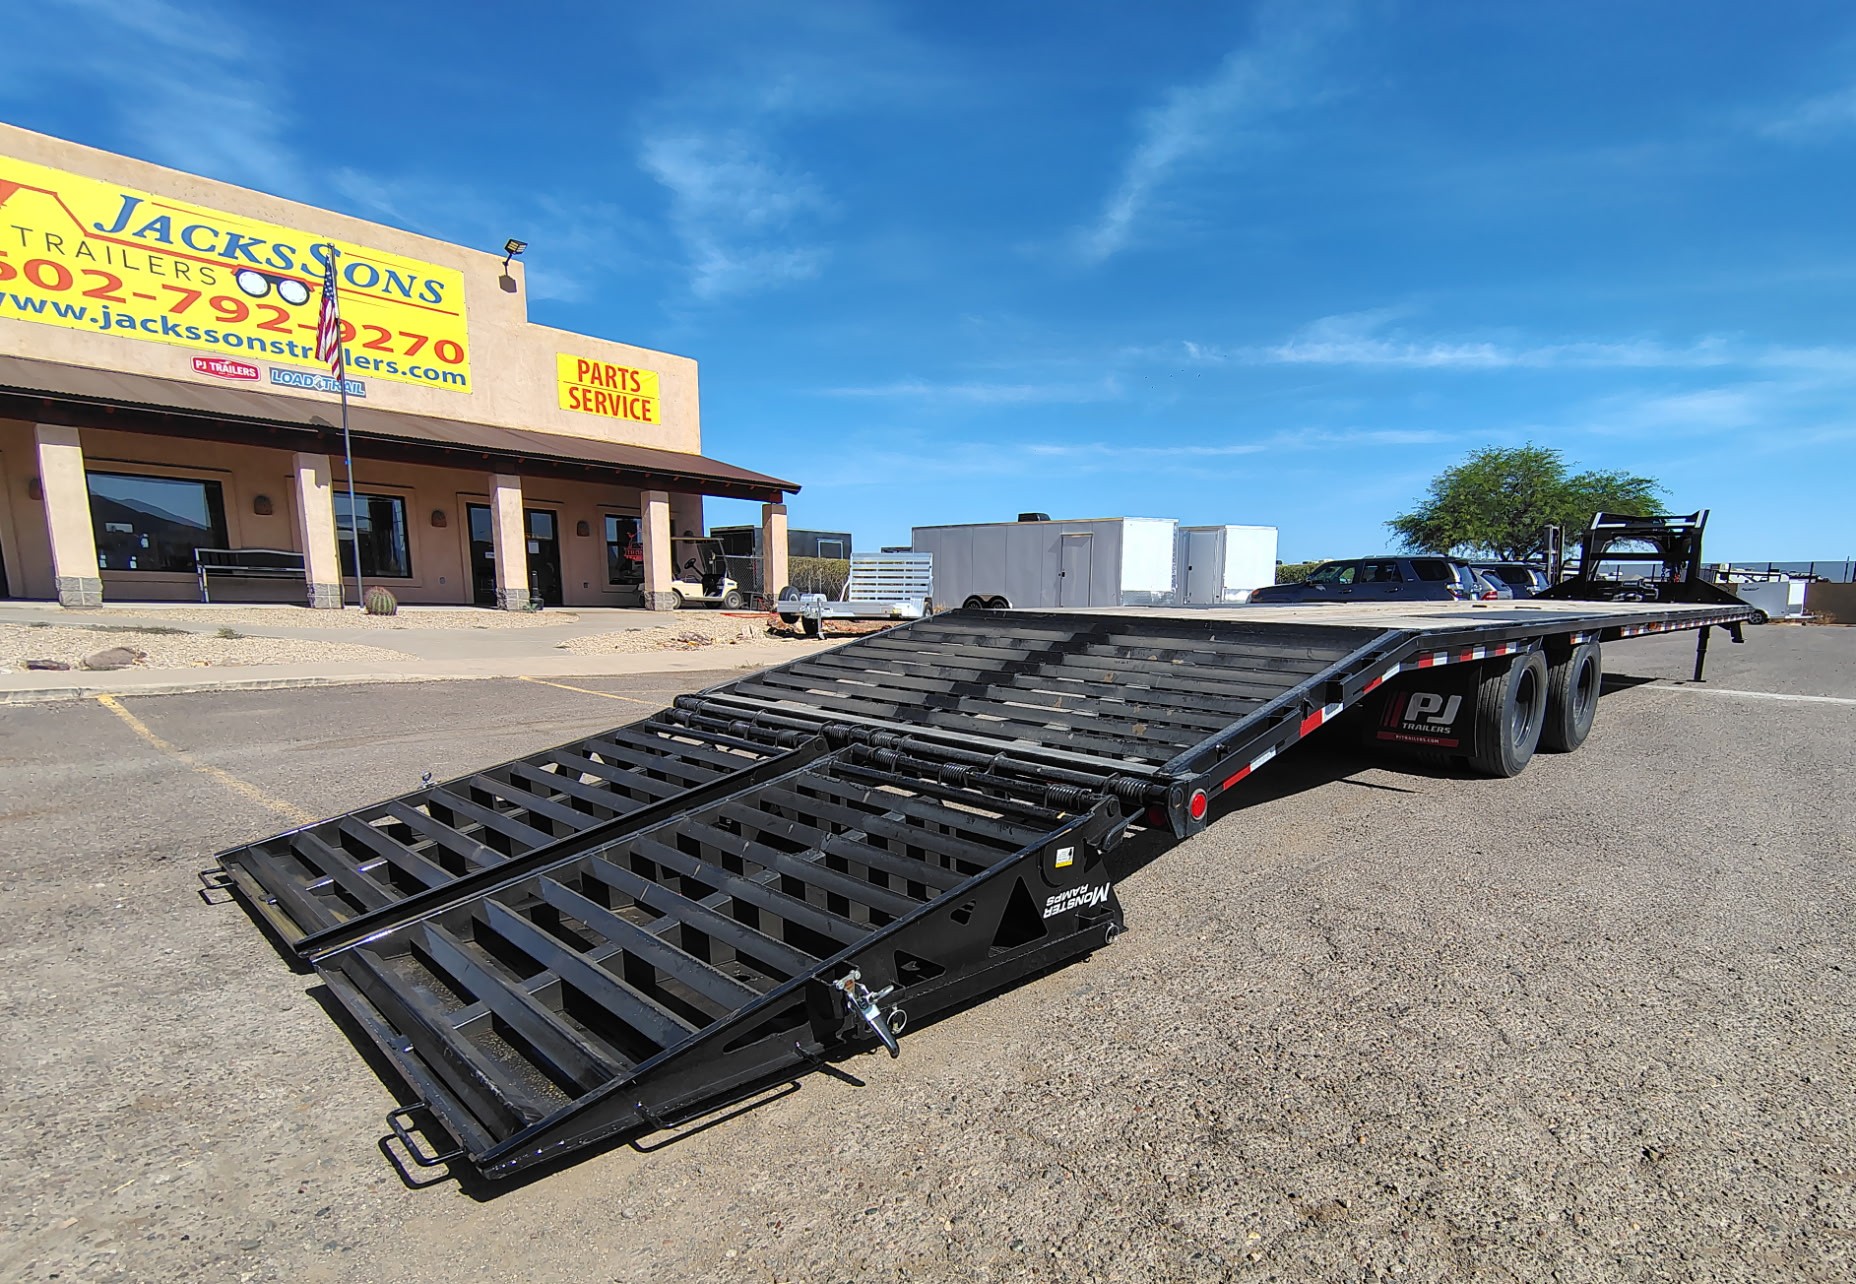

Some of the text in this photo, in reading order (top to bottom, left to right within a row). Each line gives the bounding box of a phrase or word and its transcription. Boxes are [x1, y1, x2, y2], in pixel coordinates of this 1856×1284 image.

[11, 224, 217, 286] TRAILERS
[93, 194, 445, 305] JACKSSONS
[0, 291, 467, 386] ww.jackssonstrlers.com
[195, 359, 257, 377] PJ TRAILERS
[271, 370, 315, 387] LOAD
[577, 358, 641, 393] PARTS
[568, 386, 653, 422] SERVICE
[1404, 692, 1462, 725] PJ
[1402, 722, 1452, 734] TRAILERS
[1043, 882, 1110, 919] MONSTER
[1046, 883, 1089, 907] RAMPS
